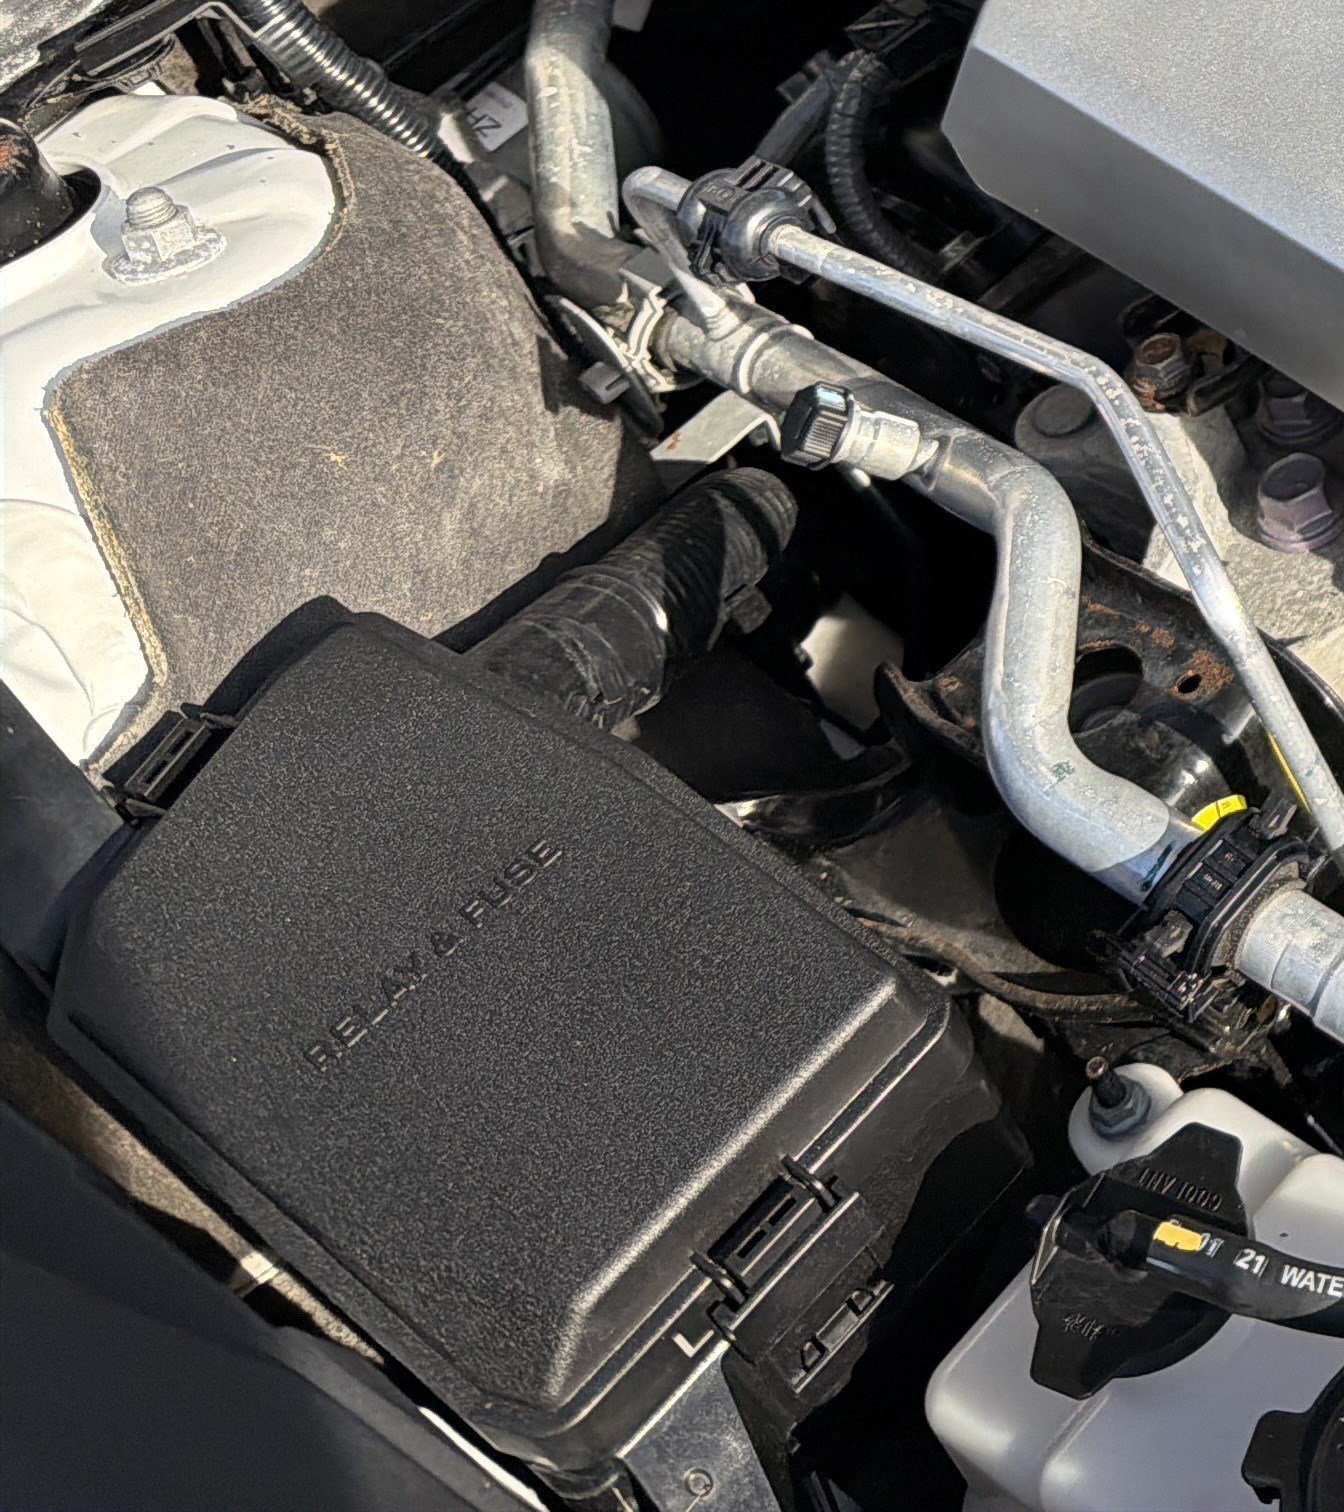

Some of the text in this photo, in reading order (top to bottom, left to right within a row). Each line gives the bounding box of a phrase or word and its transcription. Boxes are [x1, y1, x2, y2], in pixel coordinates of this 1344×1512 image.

[303, 839, 564, 1072] RELAY & FUSE
